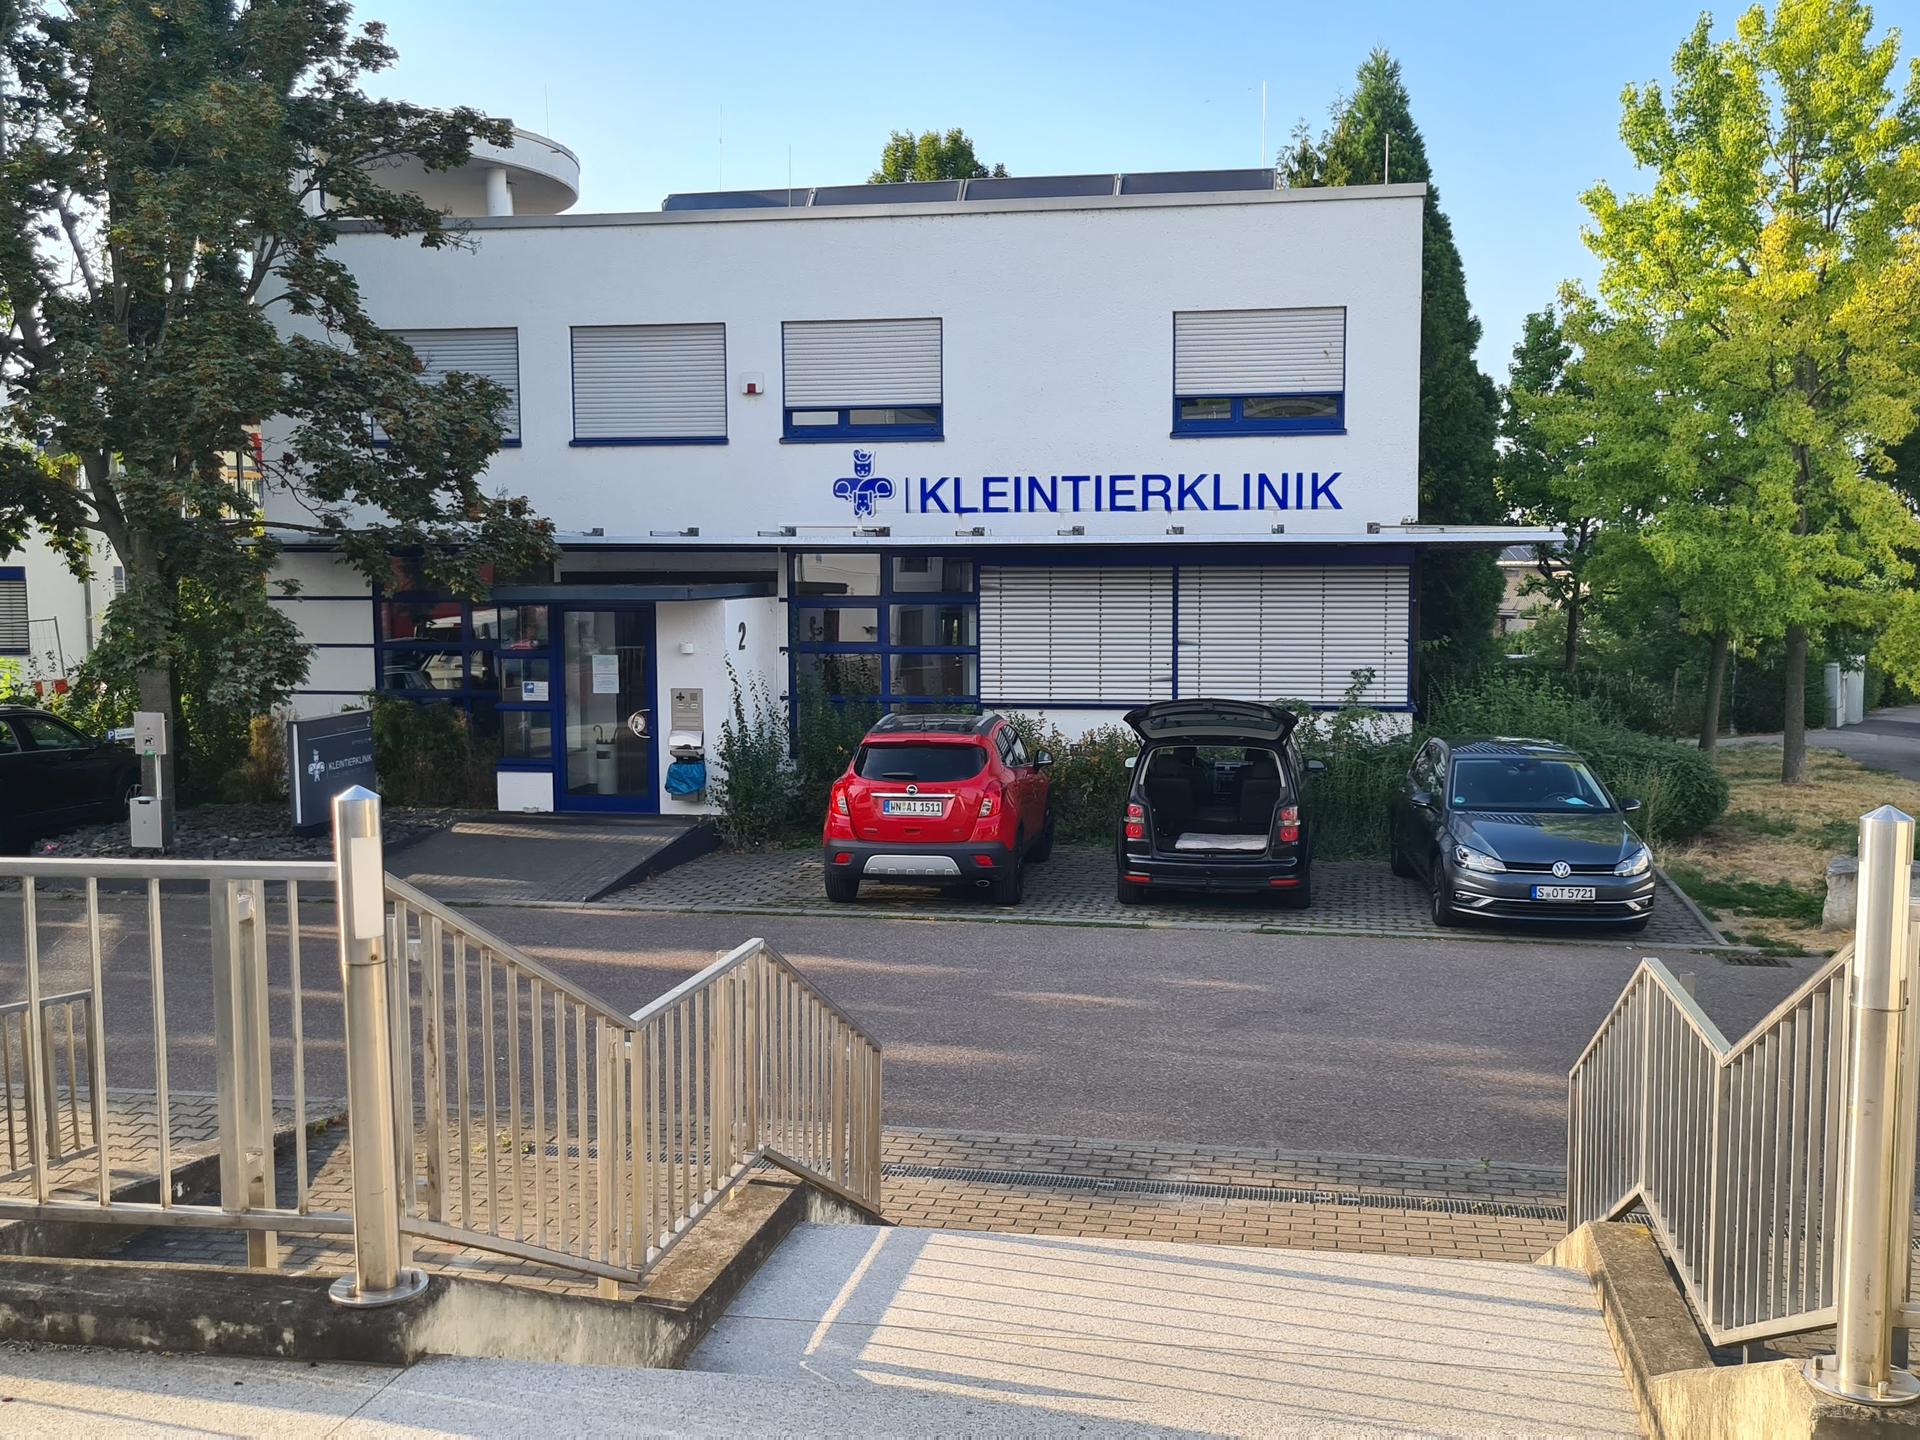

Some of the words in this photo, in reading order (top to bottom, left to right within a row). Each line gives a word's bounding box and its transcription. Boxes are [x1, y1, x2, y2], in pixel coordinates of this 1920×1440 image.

[920, 472, 1343, 513] KLEINTIERKLINIK
[738, 621, 746, 650] 2
[108, 731, 115, 740] P
[328, 754, 373, 771] KLEINTIERKLINIK
[890, 800, 901, 811] WN
[907, 801, 917, 812] AI
[920, 802, 941, 812] 1511
[1538, 888, 1544, 898] S
[1551, 888, 1565, 898] OT
[1567, 889, 1594, 899] 5721
